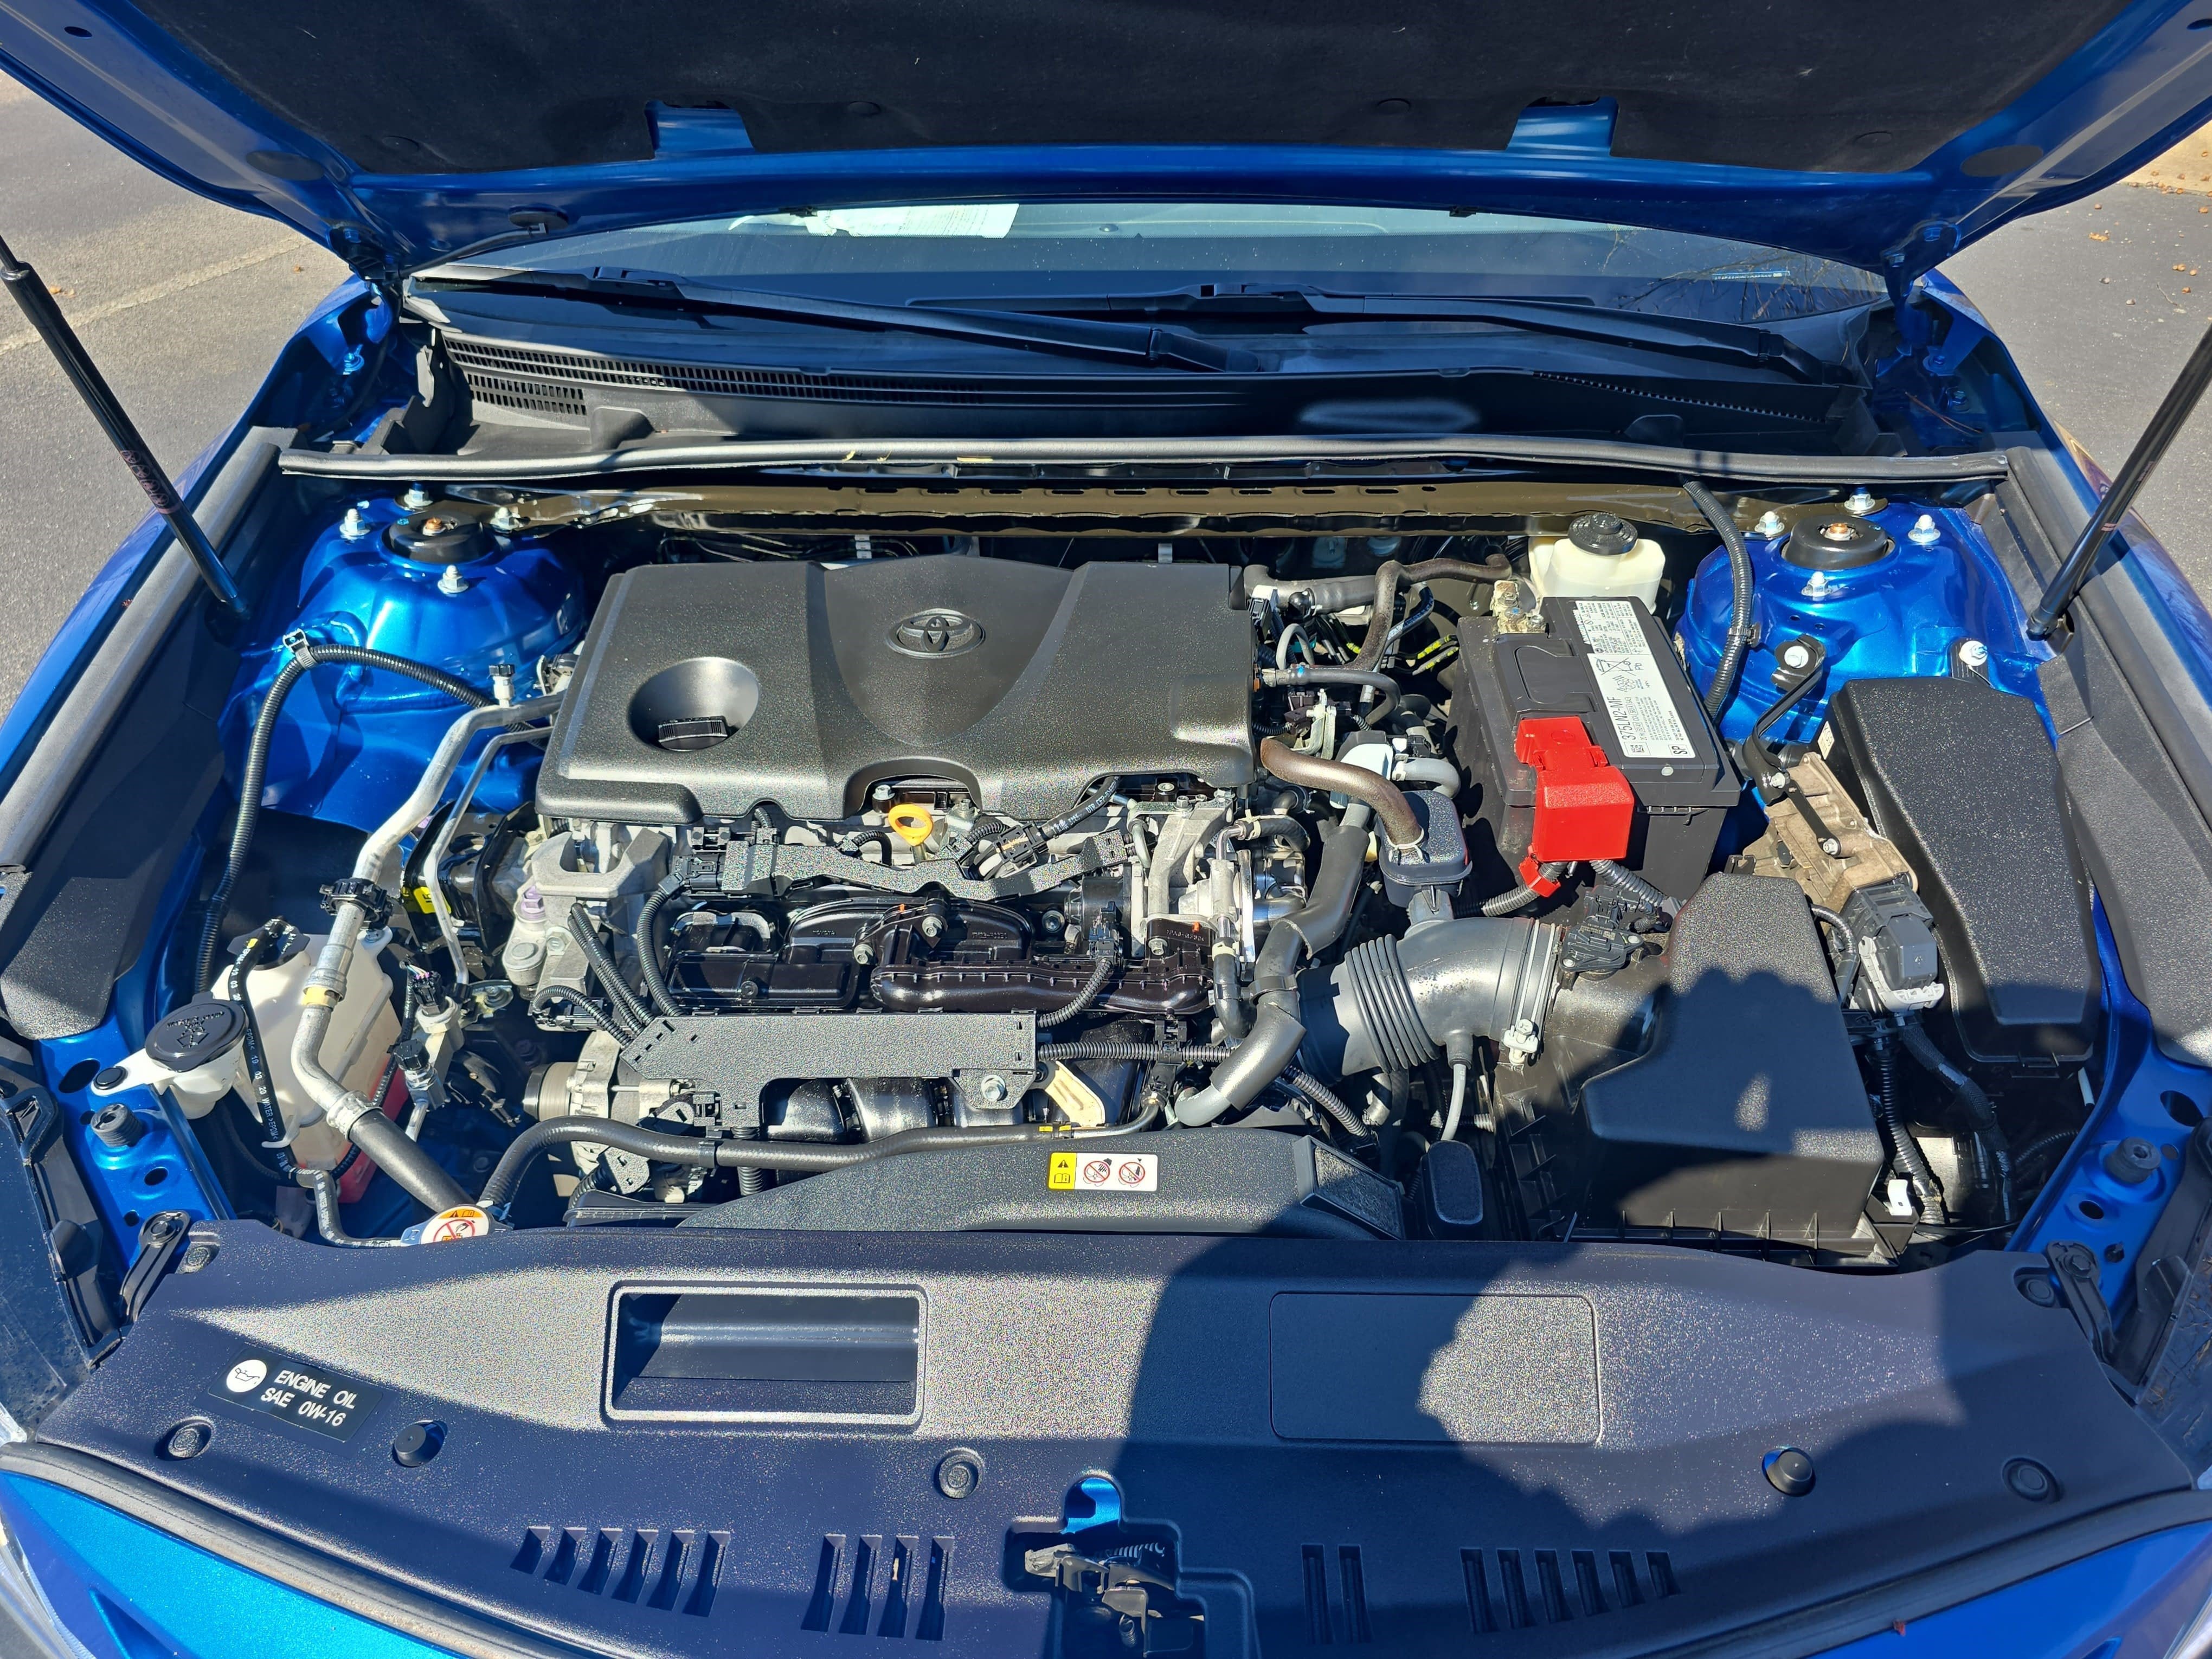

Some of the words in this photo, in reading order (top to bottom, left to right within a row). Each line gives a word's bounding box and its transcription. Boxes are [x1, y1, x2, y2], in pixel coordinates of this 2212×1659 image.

[1606, 696, 1636, 740] 375LN2-MF
[1673, 746, 1688, 755] SP
[254, 1071, 263, 1080] 03
[259, 1086, 267, 1095] 20
[262, 1097, 273, 1118] WATER
[274, 1369, 331, 1399] ENGINE
[333, 1391, 357, 1409] OIL
[260, 1387, 295, 1408] SAE
[298, 1400, 346, 1426] 0W-16
